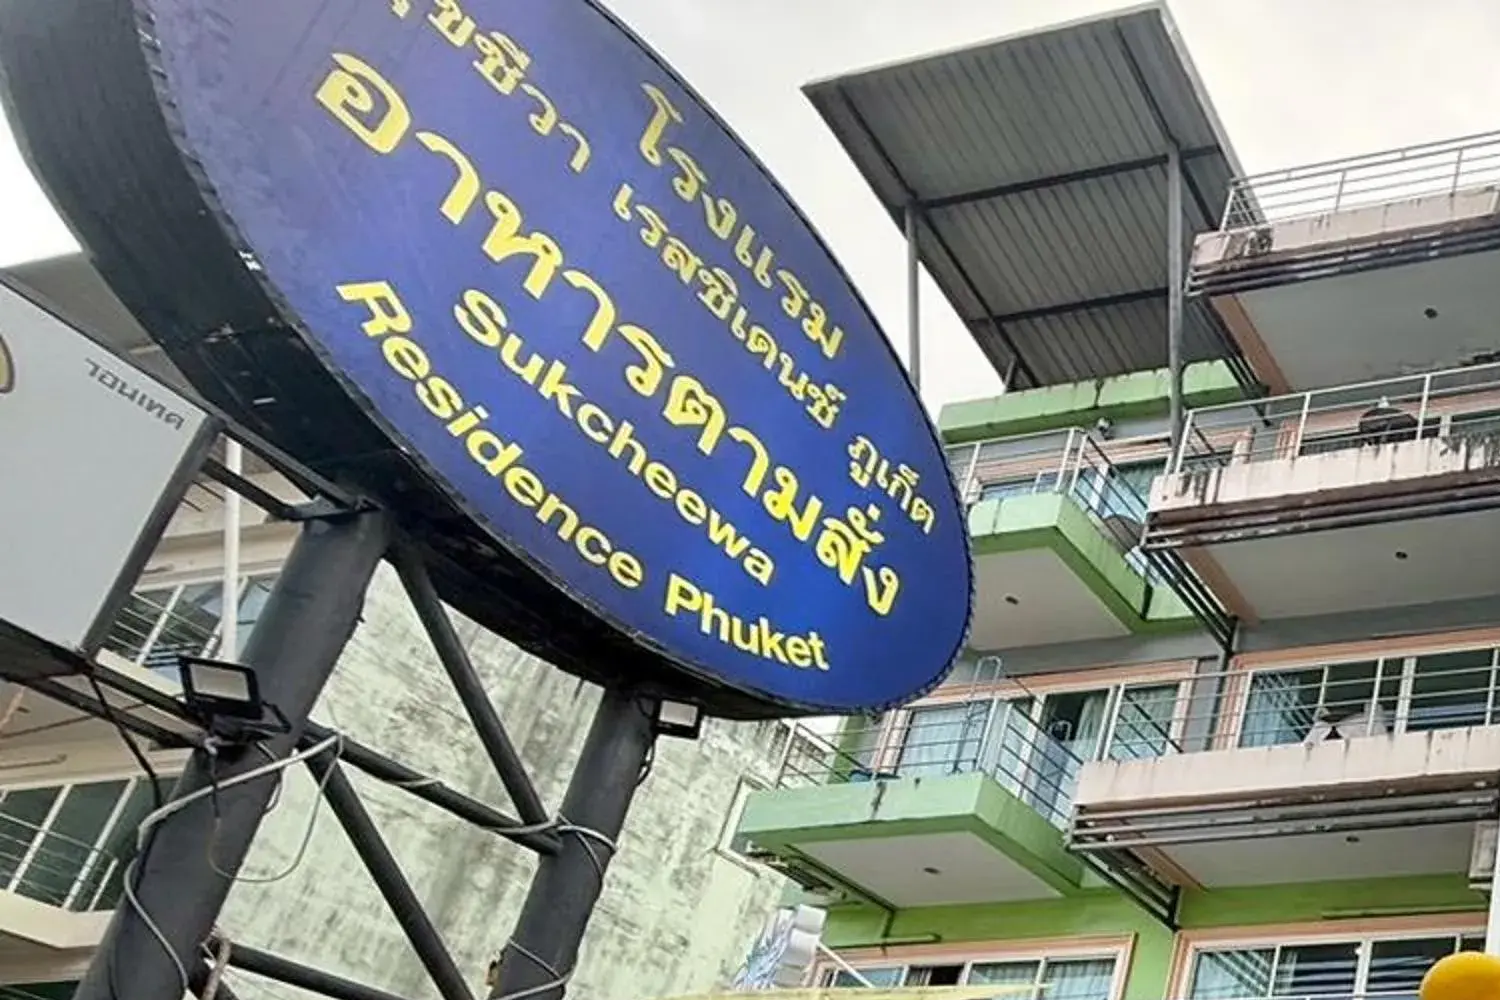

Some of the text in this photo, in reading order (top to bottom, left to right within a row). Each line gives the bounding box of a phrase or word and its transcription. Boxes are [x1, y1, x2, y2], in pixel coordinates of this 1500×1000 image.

[315, 52, 899, 616] อาหารตามสั่ง
[391, 0, 591, 173] ุขชีวา
[848, 435, 936, 535] ภูเก็ต
[640, 82, 844, 359] โรงแรม
[335, 280, 830, 671] Residence Phuket
[454, 288, 775, 587] Sukcheewa
